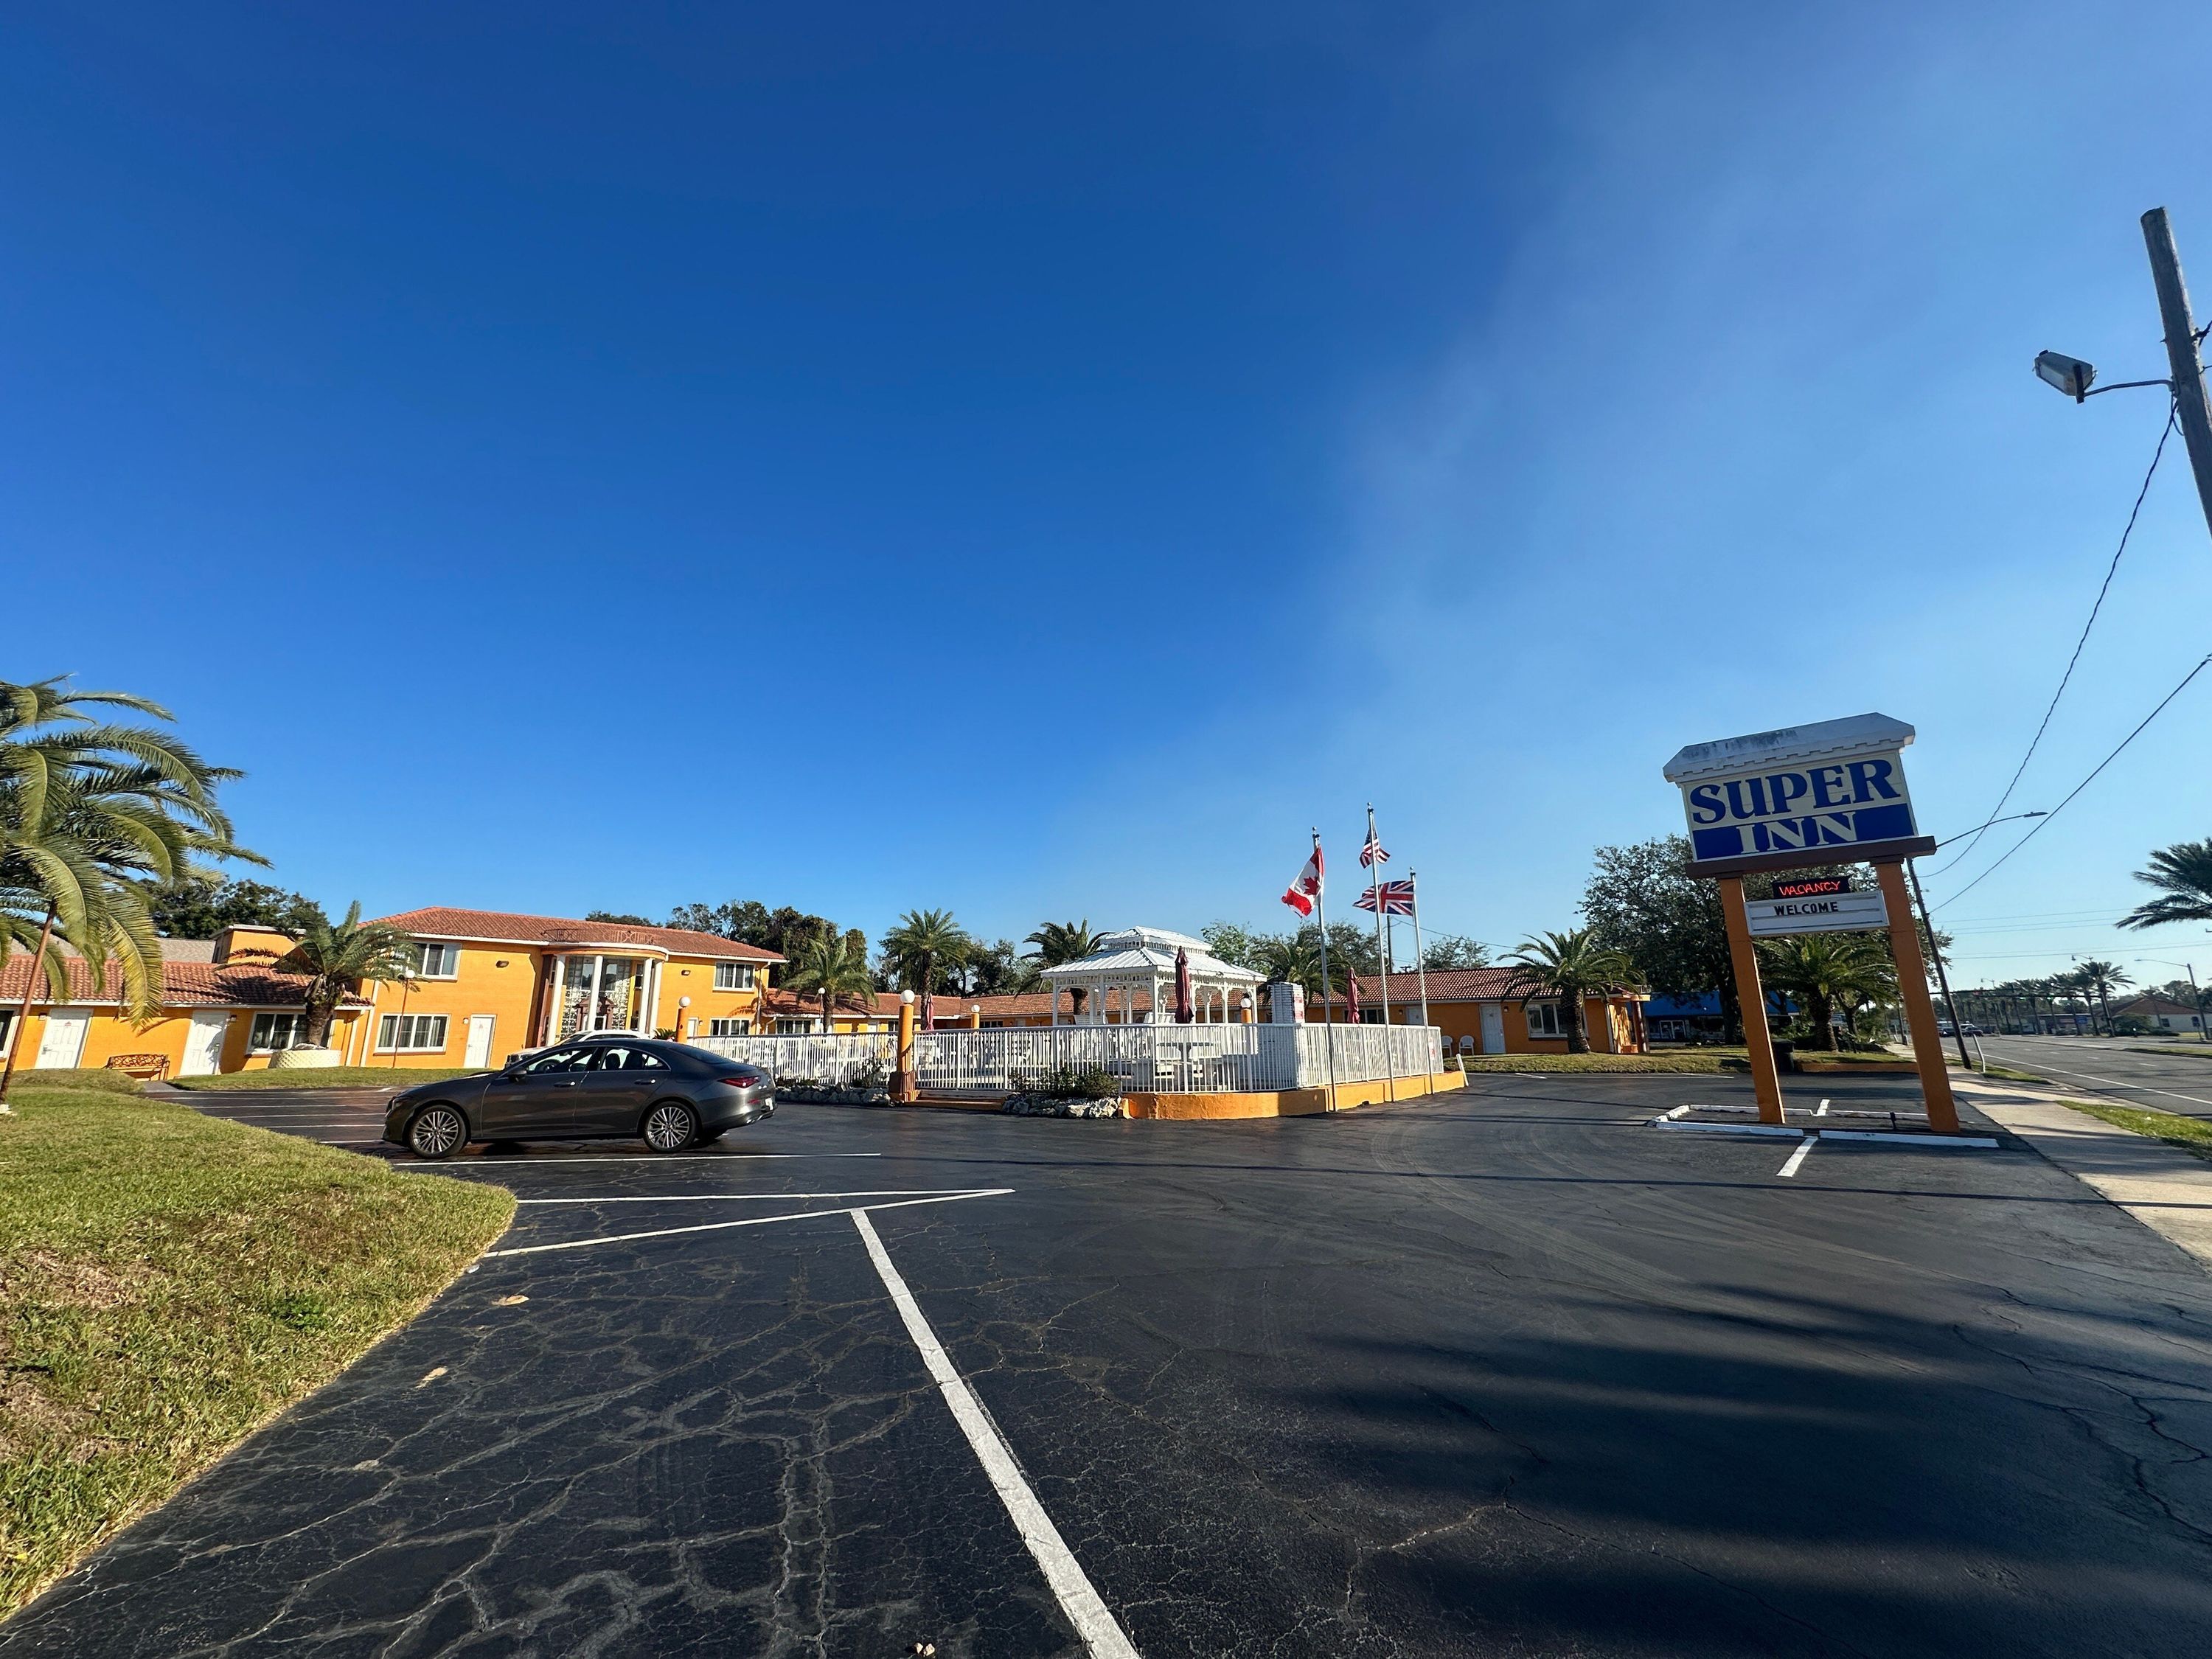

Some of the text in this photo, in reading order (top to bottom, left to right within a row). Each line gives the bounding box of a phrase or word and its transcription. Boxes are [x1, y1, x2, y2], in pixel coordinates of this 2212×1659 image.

[1689, 759, 1901, 824] SUPER
[1736, 811, 1857, 855] INN
[1778, 880, 1840, 896] VACANCY
[1774, 901, 1839, 916] WELCOME
